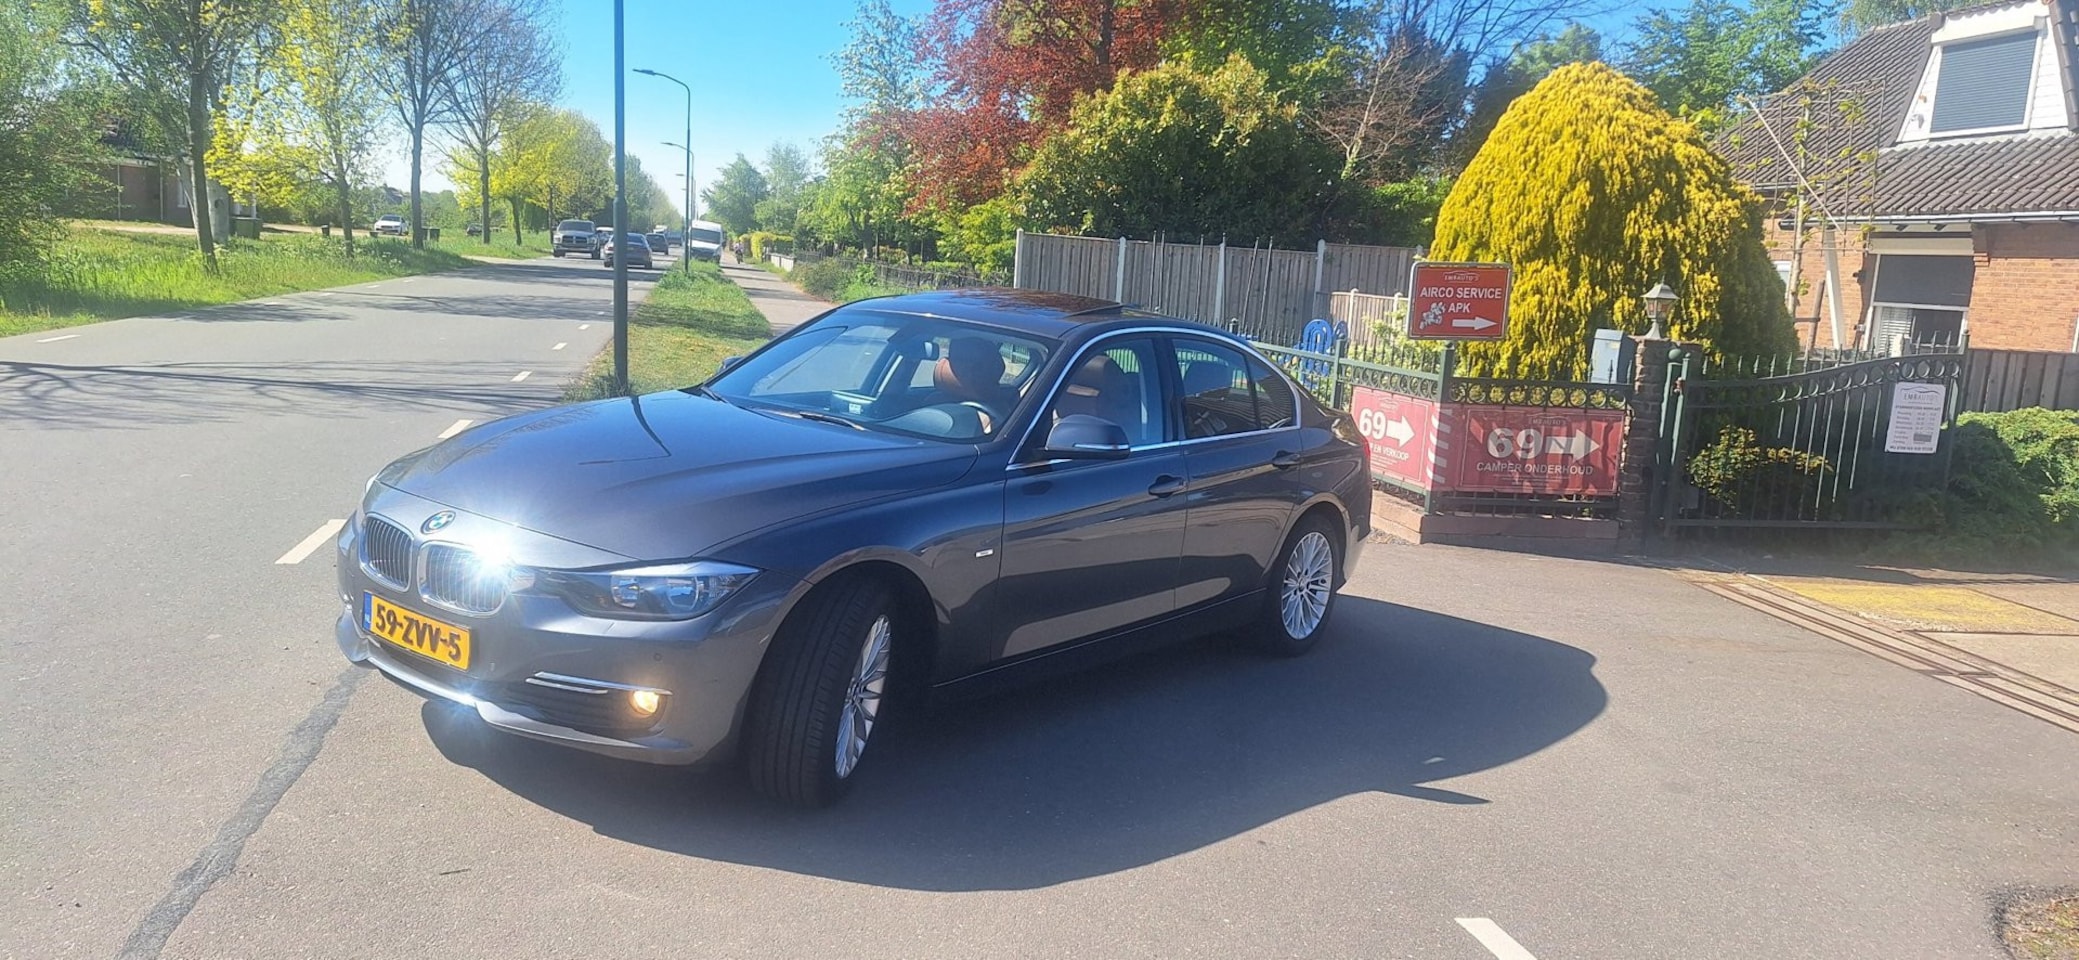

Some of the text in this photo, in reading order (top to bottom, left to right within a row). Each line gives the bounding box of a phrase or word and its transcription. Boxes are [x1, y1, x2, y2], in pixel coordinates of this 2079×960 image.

[1420, 287, 1502, 299] AIRCO SERVICE
[1448, 302, 1471, 313] APK
[1359, 408, 1386, 440] 69
[1487, 427, 1542, 459] 69
[1476, 462, 1593, 475] CAMPER ONDERHOUD
[375, 603, 462, 662] 59-ZVV-5
